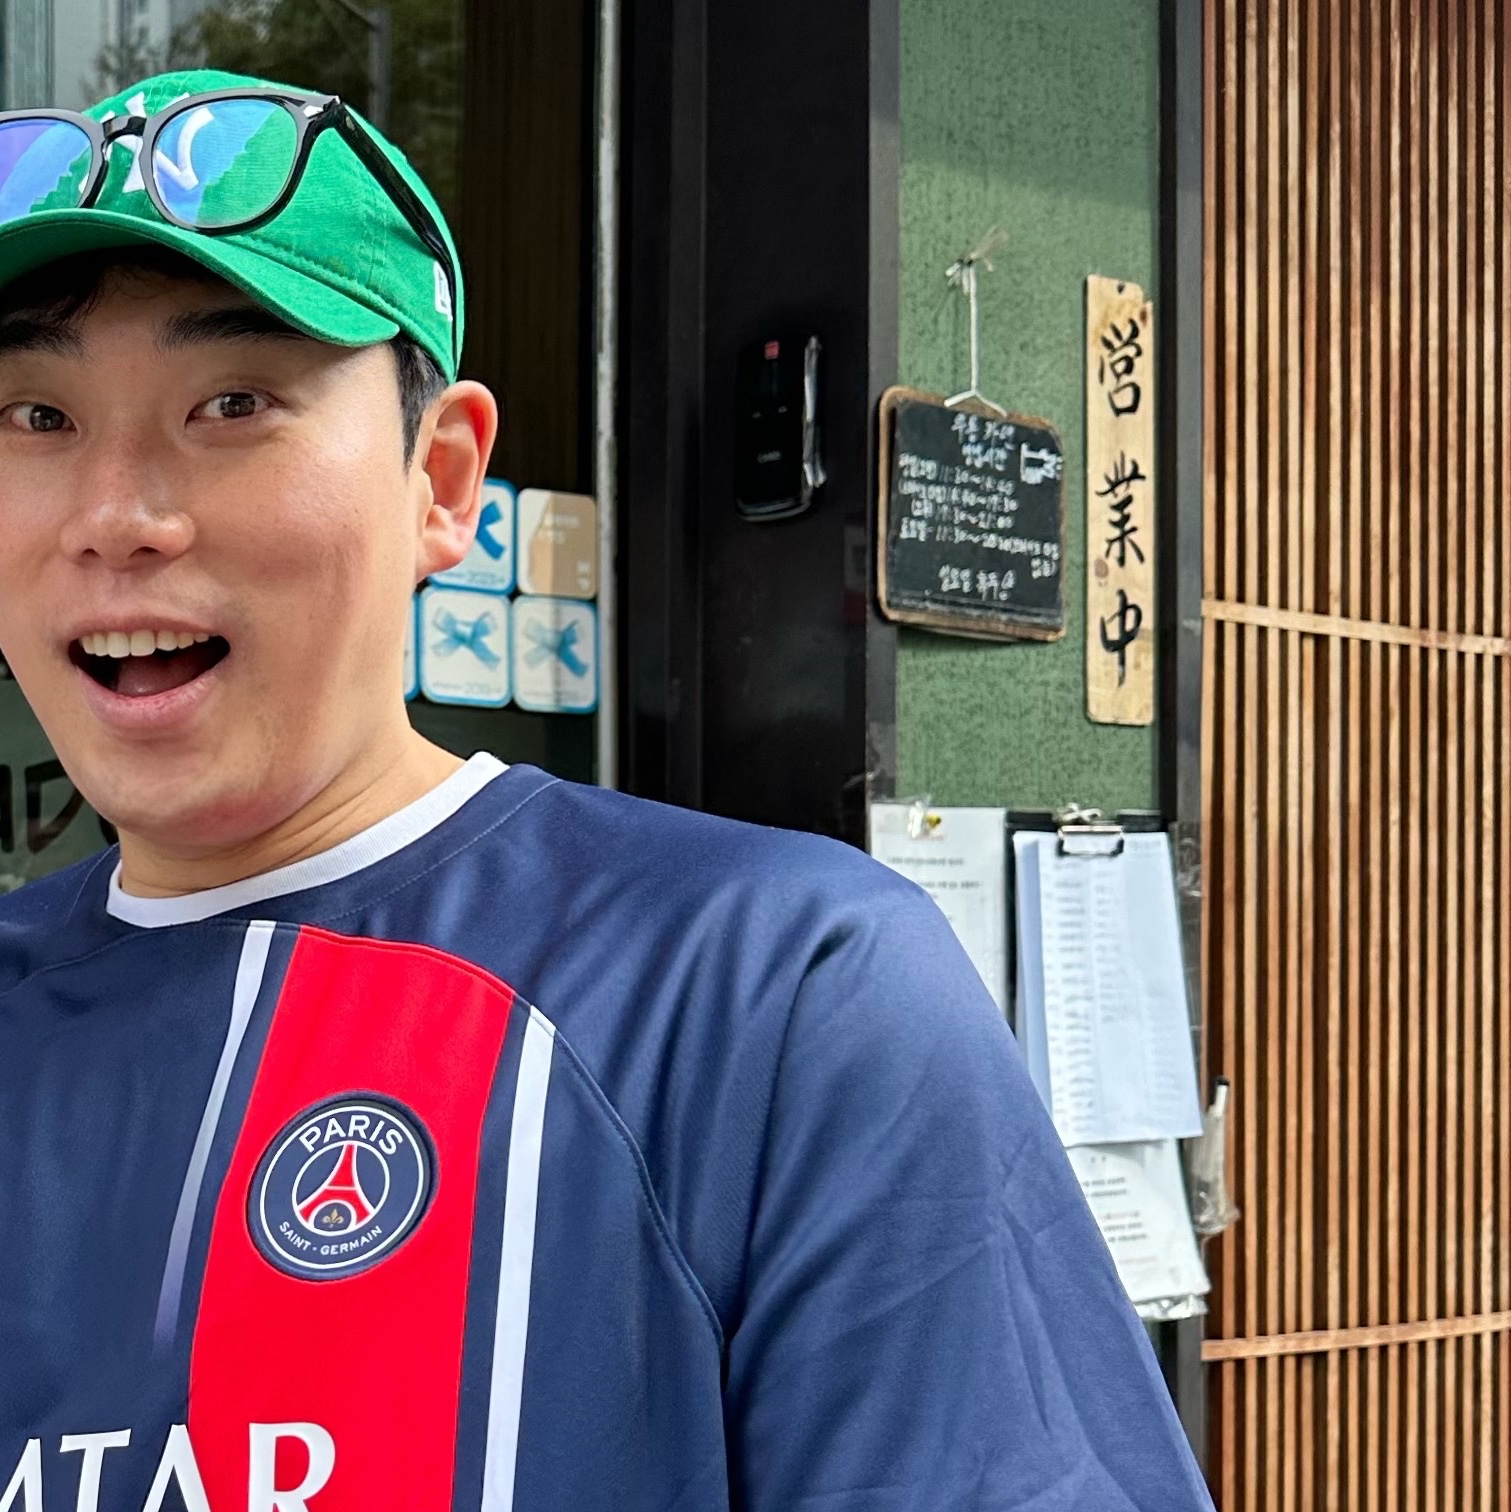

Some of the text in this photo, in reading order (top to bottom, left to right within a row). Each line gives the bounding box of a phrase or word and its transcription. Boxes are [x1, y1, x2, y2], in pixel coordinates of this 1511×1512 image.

[299, 1114, 403, 1155] PARIS
[279, 1221, 312, 1251] SAINT
[320, 1225, 383, 1256] GERMAIN
